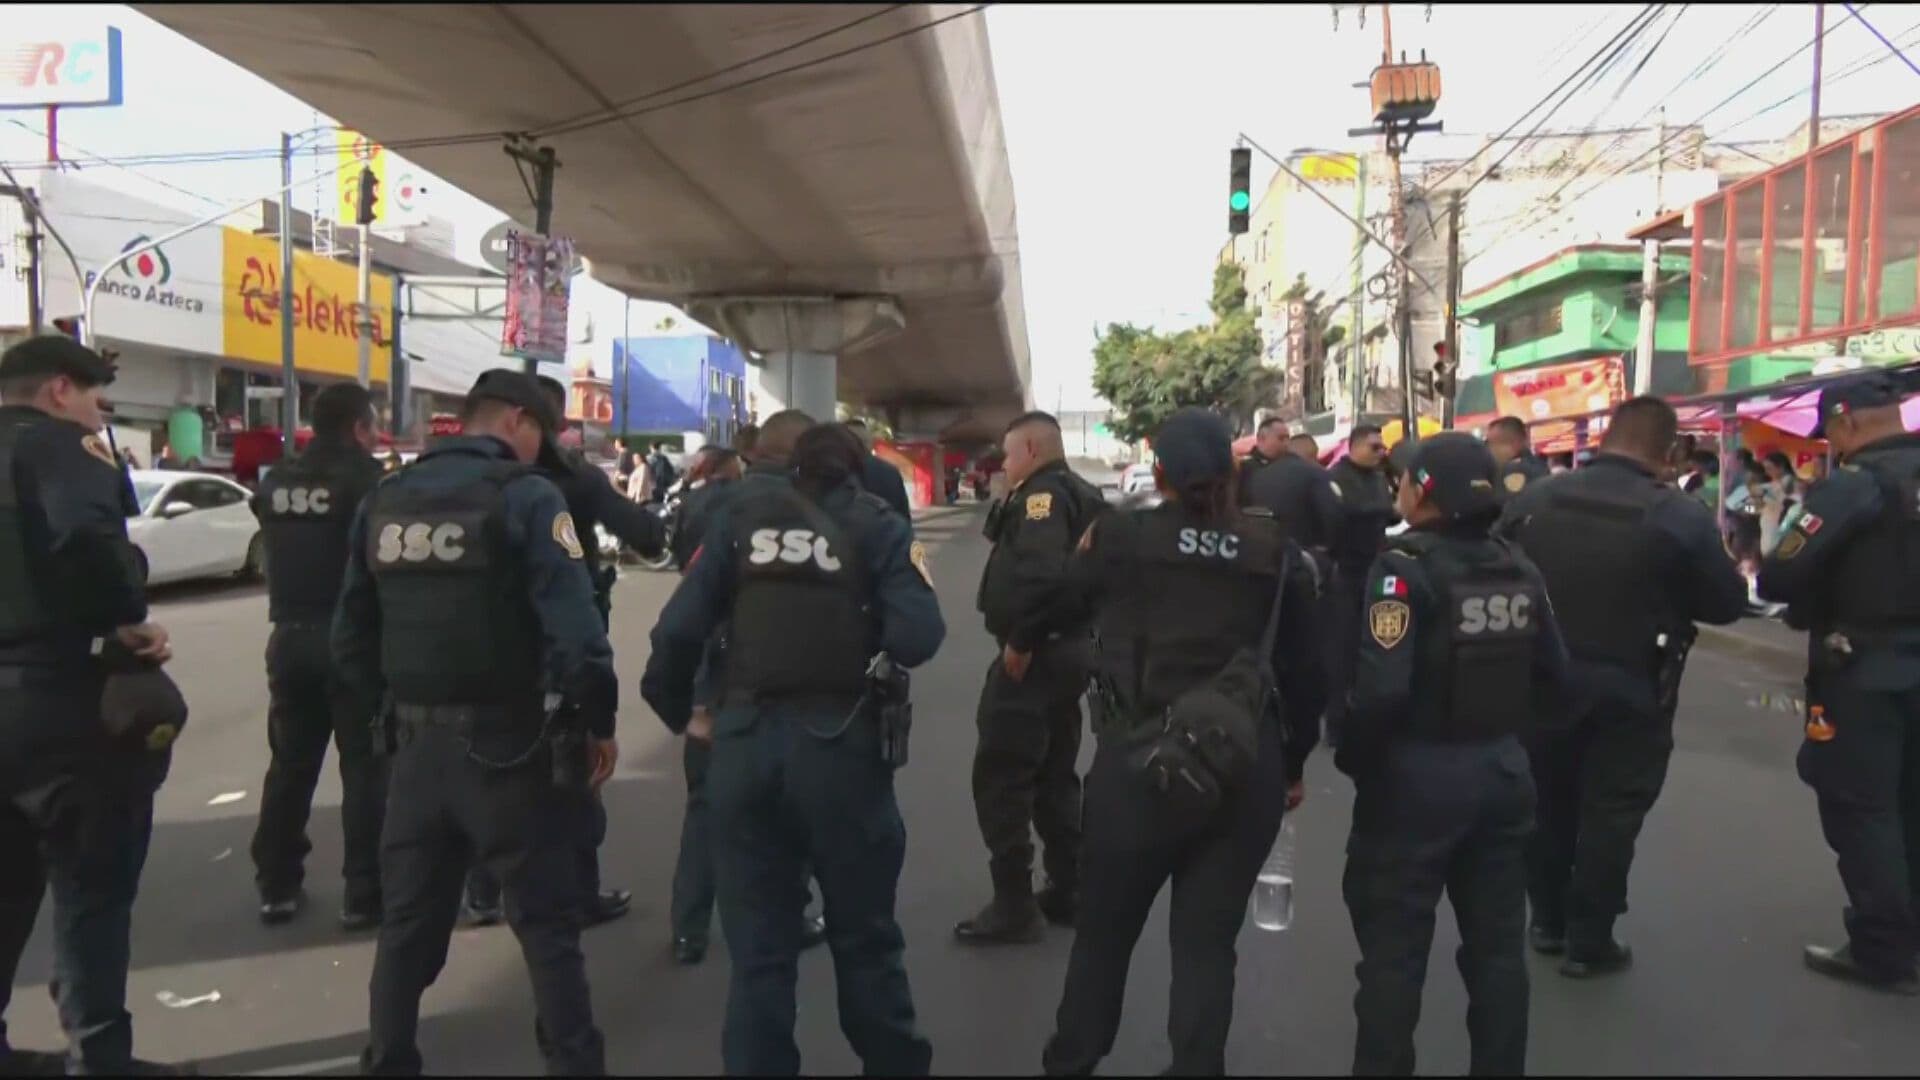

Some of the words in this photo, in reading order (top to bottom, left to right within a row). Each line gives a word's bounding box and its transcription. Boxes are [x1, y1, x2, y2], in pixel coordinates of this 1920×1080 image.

[145, 283, 204, 314] Azteca
[287, 285, 386, 347] elekta
[271, 487, 330, 515] SSC
[377, 521, 466, 564] SSC
[1177, 527, 1240, 560] SSC
[1458, 593, 1531, 635] SSC
